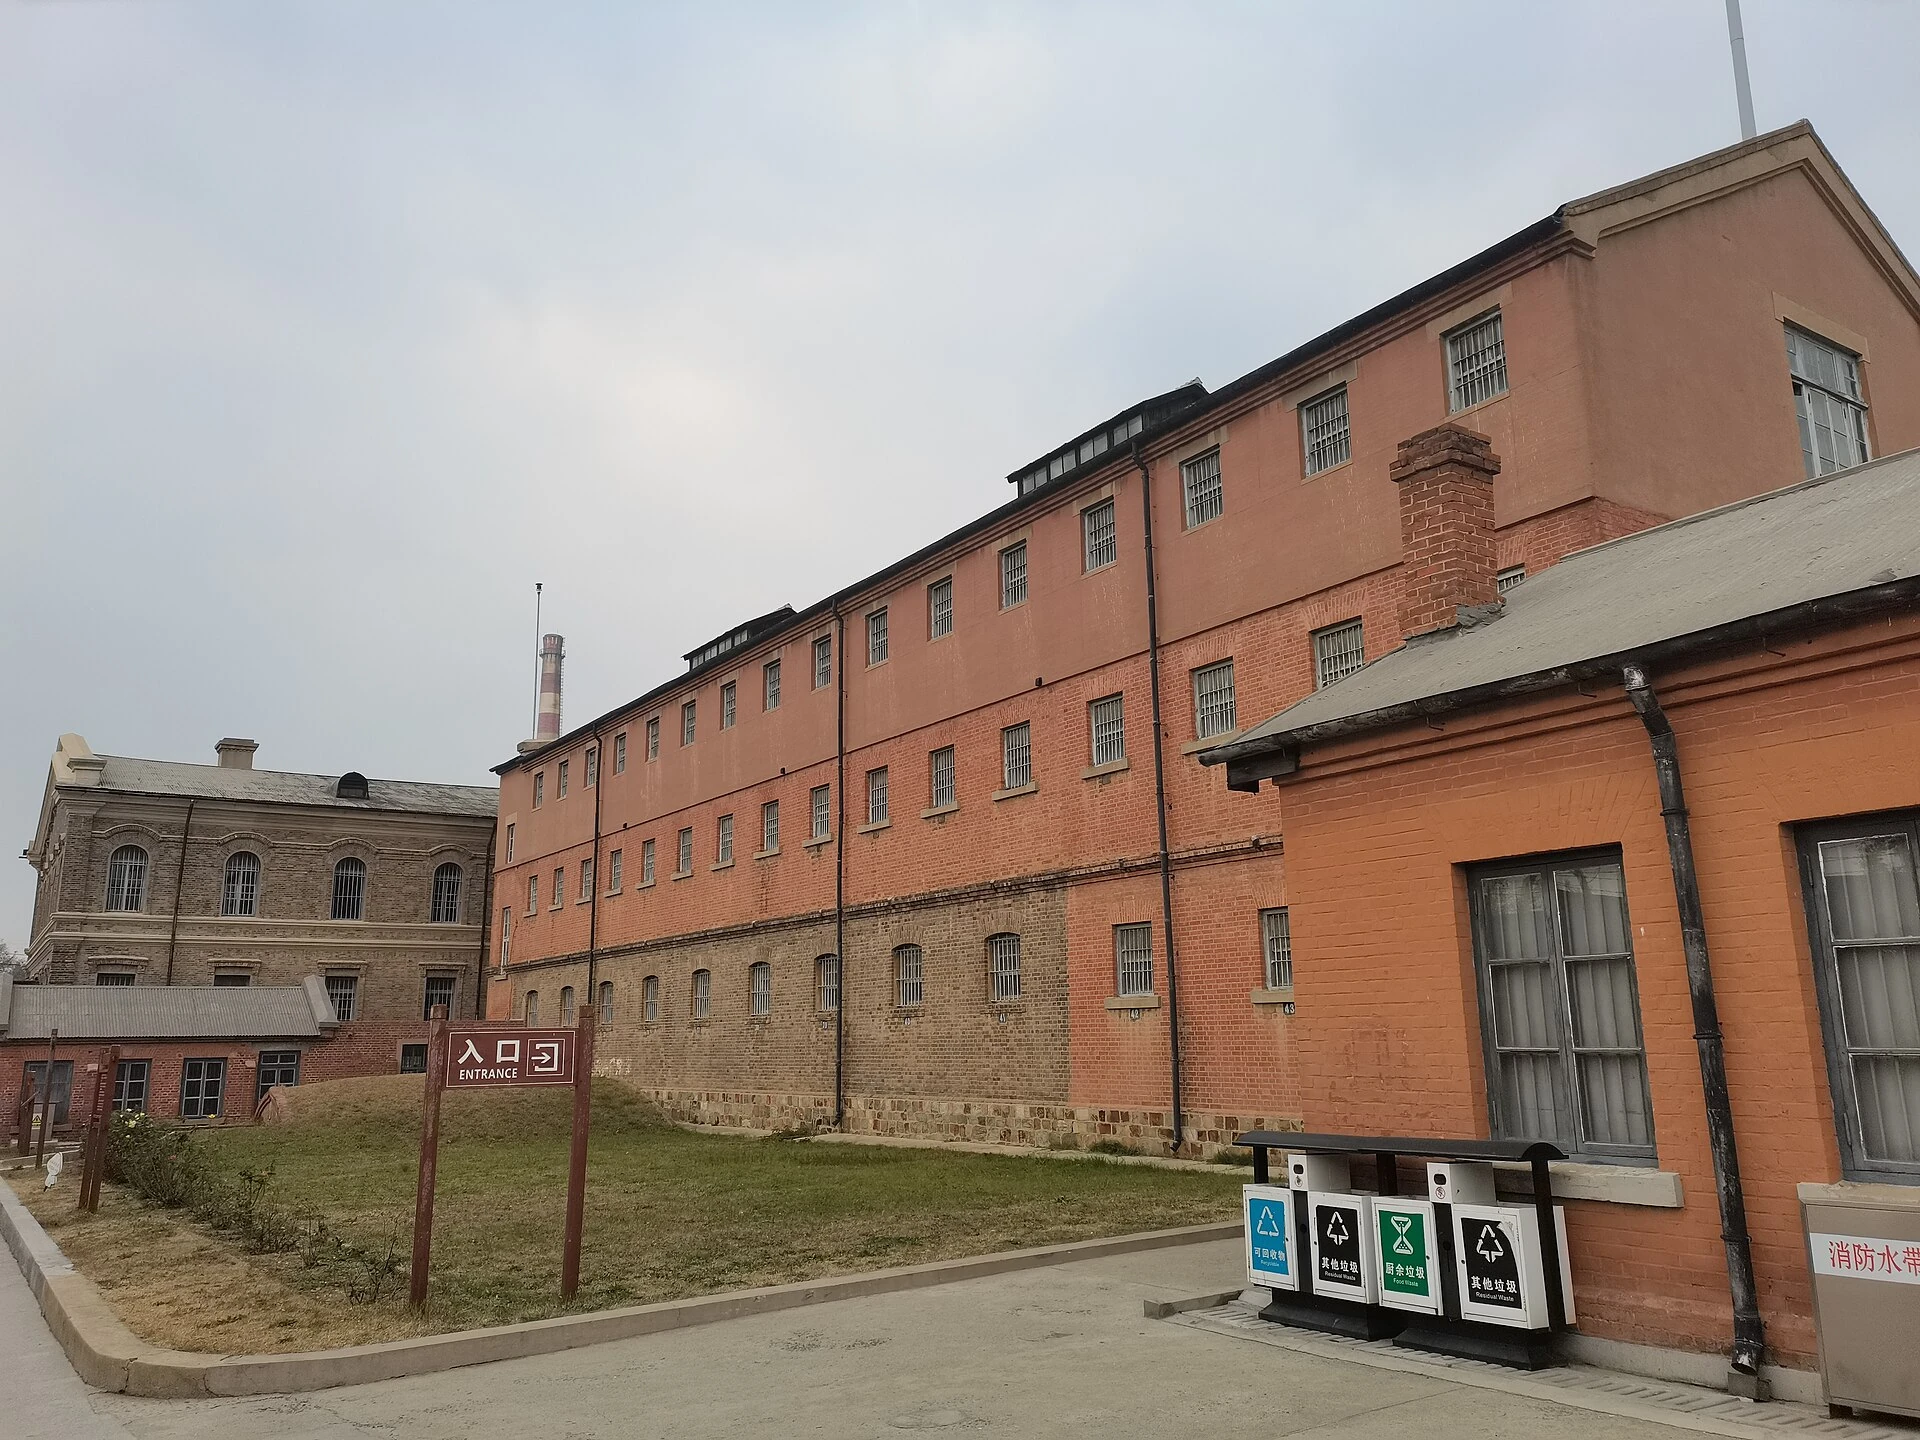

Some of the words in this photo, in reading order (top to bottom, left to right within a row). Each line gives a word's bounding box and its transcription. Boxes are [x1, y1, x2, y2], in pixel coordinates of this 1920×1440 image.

[457, 1038, 520, 1065] 入口
[459, 1067, 518, 1080] ENTRANCE
[1253, 1246, 1286, 1262] 可回收物
[1828, 1240, 1920, 1277] 消防水带
[1321, 1256, 1359, 1274] 其他垃圾
[1385, 1262, 1425, 1279] 厨余垃圾
[1324, 1270, 1343, 1279] Residual
[1393, 1277, 1404, 1285] Food
[1470, 1275, 1518, 1294] 其他垃圾
[1475, 1291, 1498, 1300] Residual
[1498, 1294, 1515, 1302] Waste
